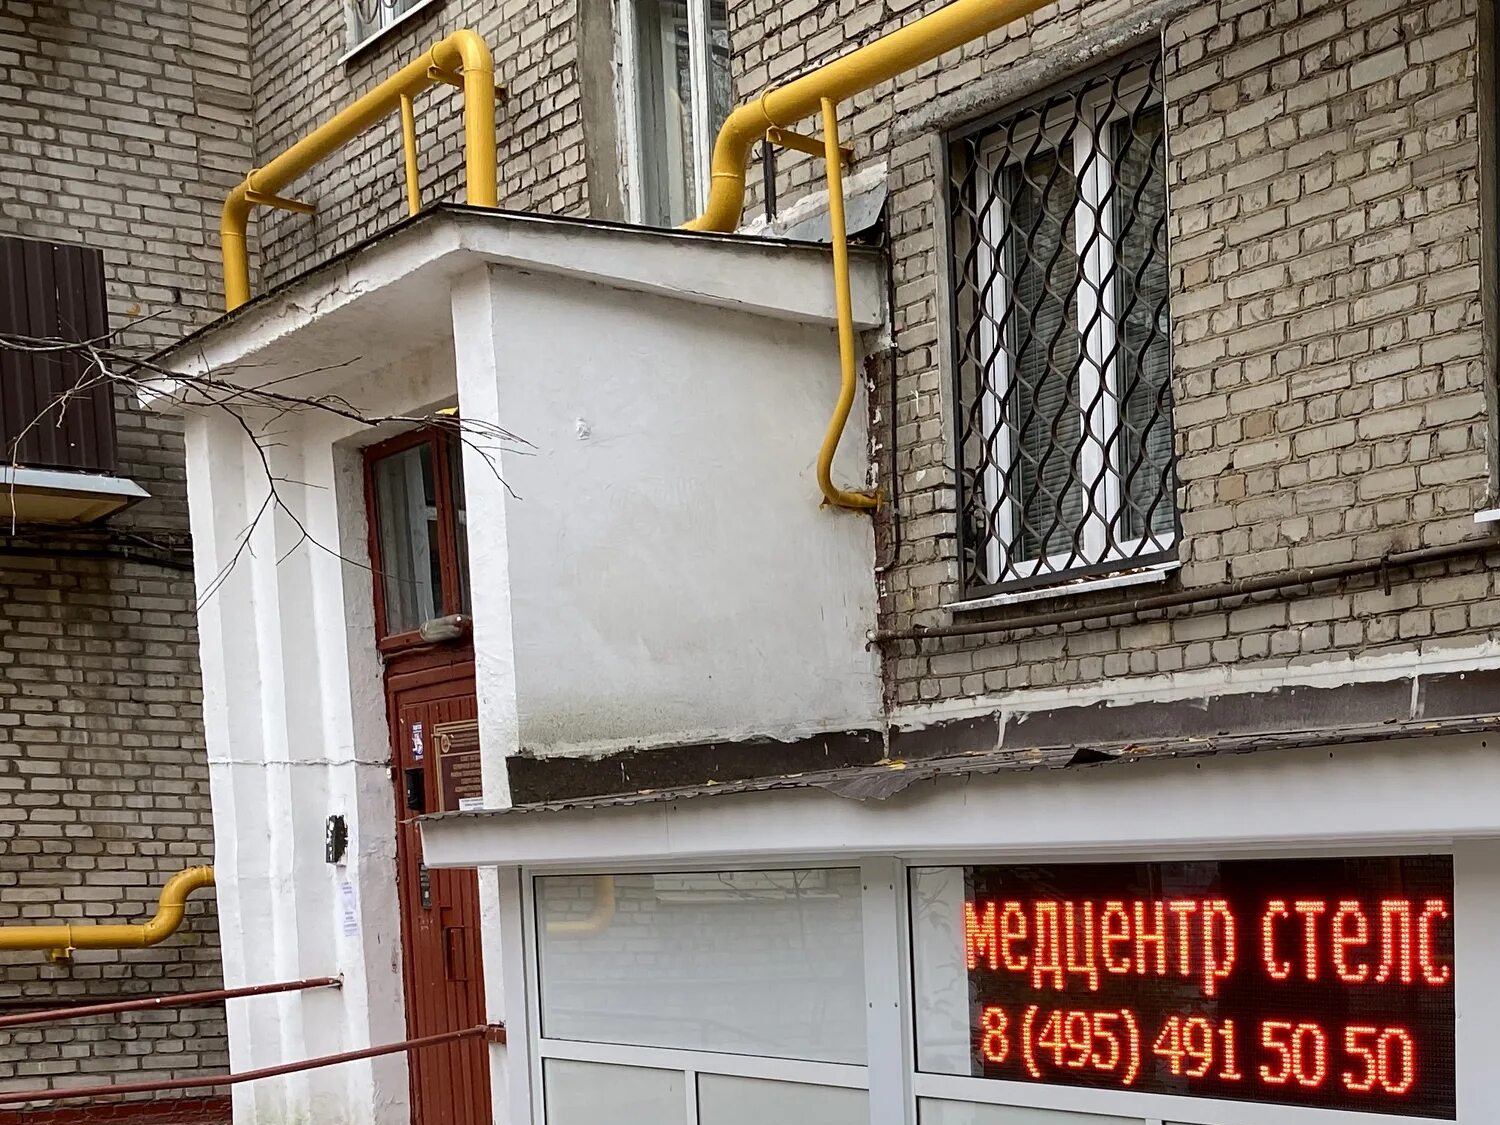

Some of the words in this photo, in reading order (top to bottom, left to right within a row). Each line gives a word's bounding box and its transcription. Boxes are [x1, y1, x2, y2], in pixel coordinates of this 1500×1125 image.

[964, 899, 1236, 997] медцентр
[1261, 899, 1450, 985] стелс
[980, 1006, 1009, 1062] 8
[1022, 1005, 1140, 1085] (495)
[1152, 1016, 1241, 1081] 491
[1259, 1021, 1326, 1087] 50
[1343, 1025, 1414, 1094] 50
